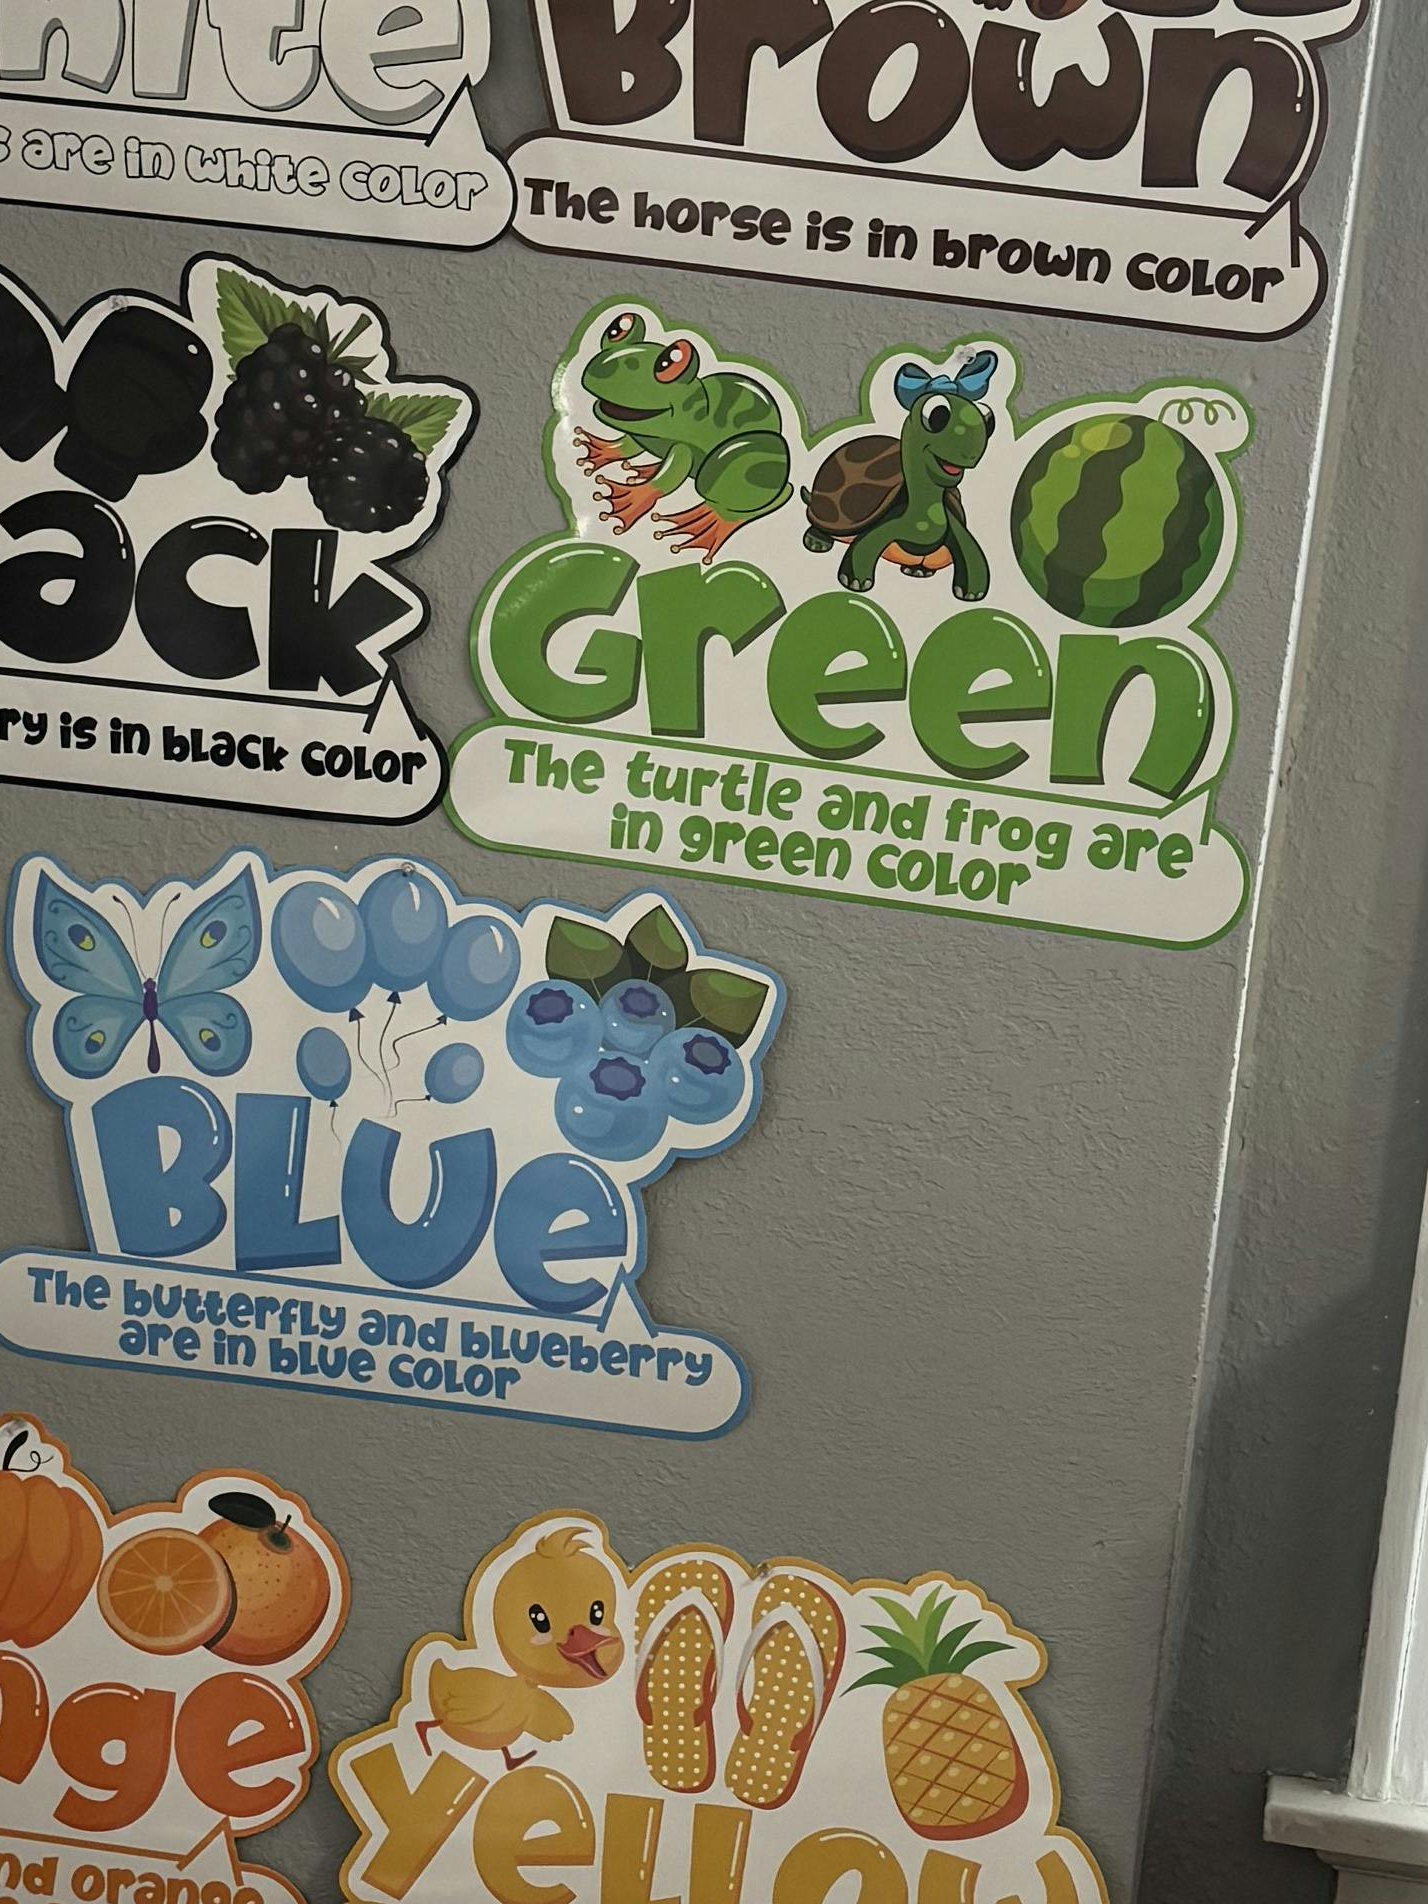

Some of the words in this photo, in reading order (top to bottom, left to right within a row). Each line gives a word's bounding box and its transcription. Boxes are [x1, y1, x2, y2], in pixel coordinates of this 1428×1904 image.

[22, 127, 114, 175] are
[124, 135, 175, 182] in
[186, 142, 330, 196] white
[524, 177, 611, 225] The
[633, 188, 792, 246] horse
[806, 210, 851, 251] is
[866, 217, 918, 261] in
[932, 227, 1111, 284] brown
[489, 540, 1215, 800] Green
[60, 712, 97, 750] is
[109, 716, 151, 756] in
[504, 737, 605, 795] The
[626, 748, 796, 816] turtle
[819, 781, 936, 841] and
[946, 795, 1072, 869] frog
[1087, 823, 1194, 879] are
[610, 805, 663, 851] in
[681, 816, 852, 883] green
[27, 1267, 112, 1310] The
[360, 1309, 446, 1355] and
[119, 1319, 204, 1360] are
[214, 1328, 256, 1369] in
